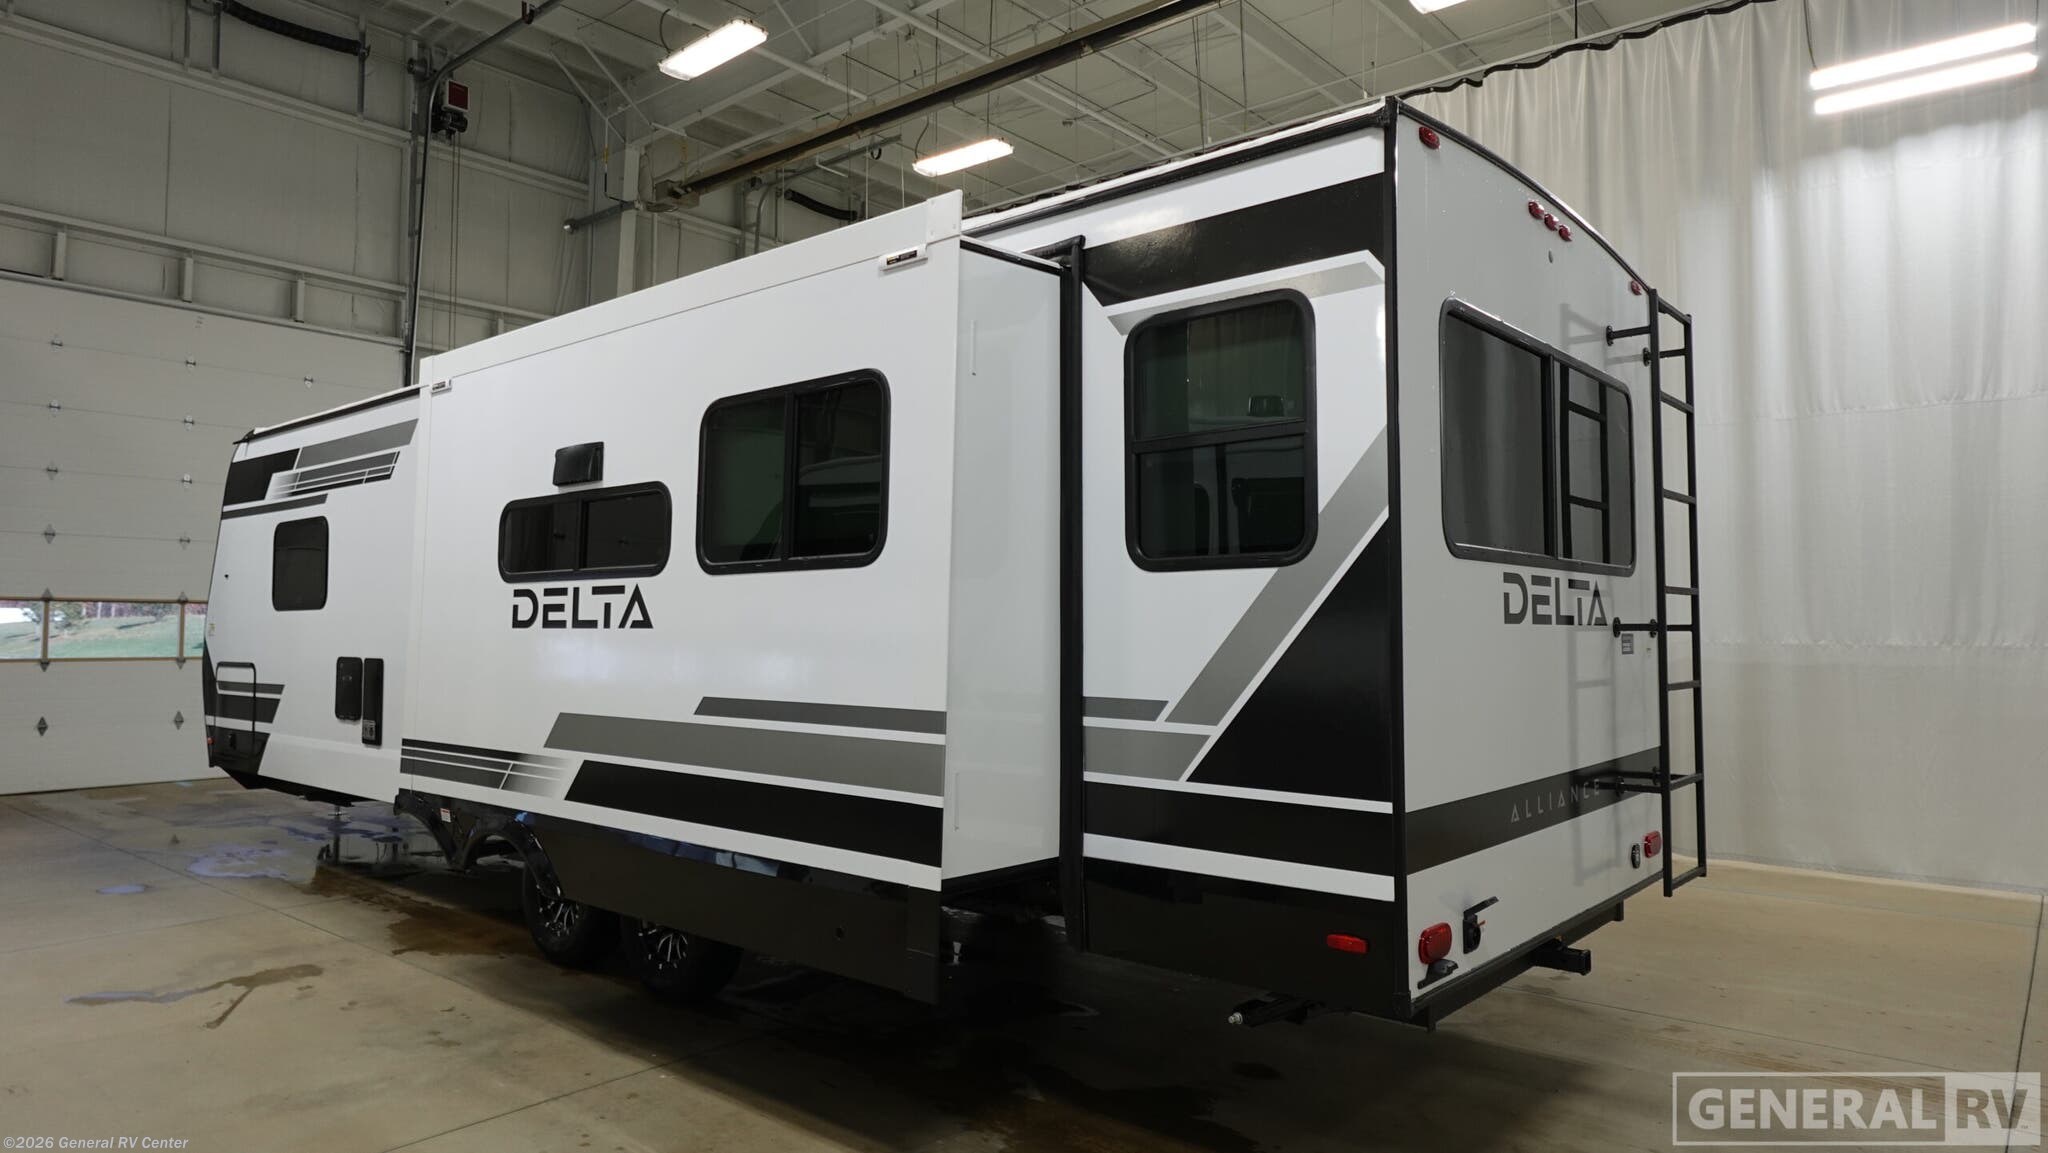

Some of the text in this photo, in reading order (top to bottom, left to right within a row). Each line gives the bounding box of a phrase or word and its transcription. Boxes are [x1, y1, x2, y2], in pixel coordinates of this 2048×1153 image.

[512, 583, 654, 629] DELTA
[1503, 572, 1608, 626] DELTA
[1510, 778, 1600, 823] ALLIANCE
